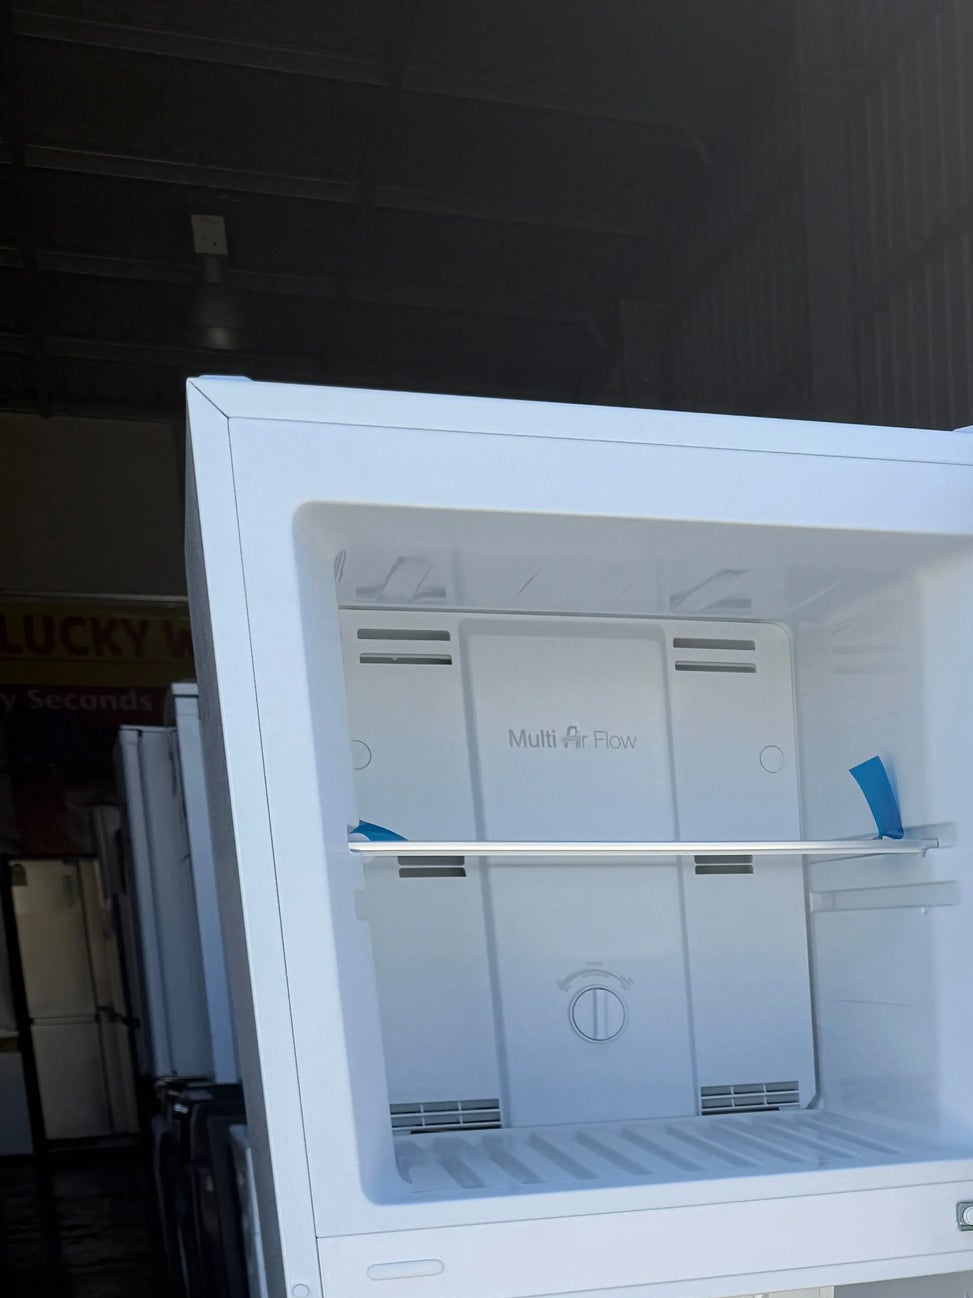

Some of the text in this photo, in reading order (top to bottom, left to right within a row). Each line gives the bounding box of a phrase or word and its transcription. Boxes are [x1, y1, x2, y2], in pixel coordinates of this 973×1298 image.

[0, 614, 150, 657] LUCKY
[27, 689, 152, 711] Seconds
[508, 728, 557, 748] Multi
[594, 730, 637, 749] Flow
